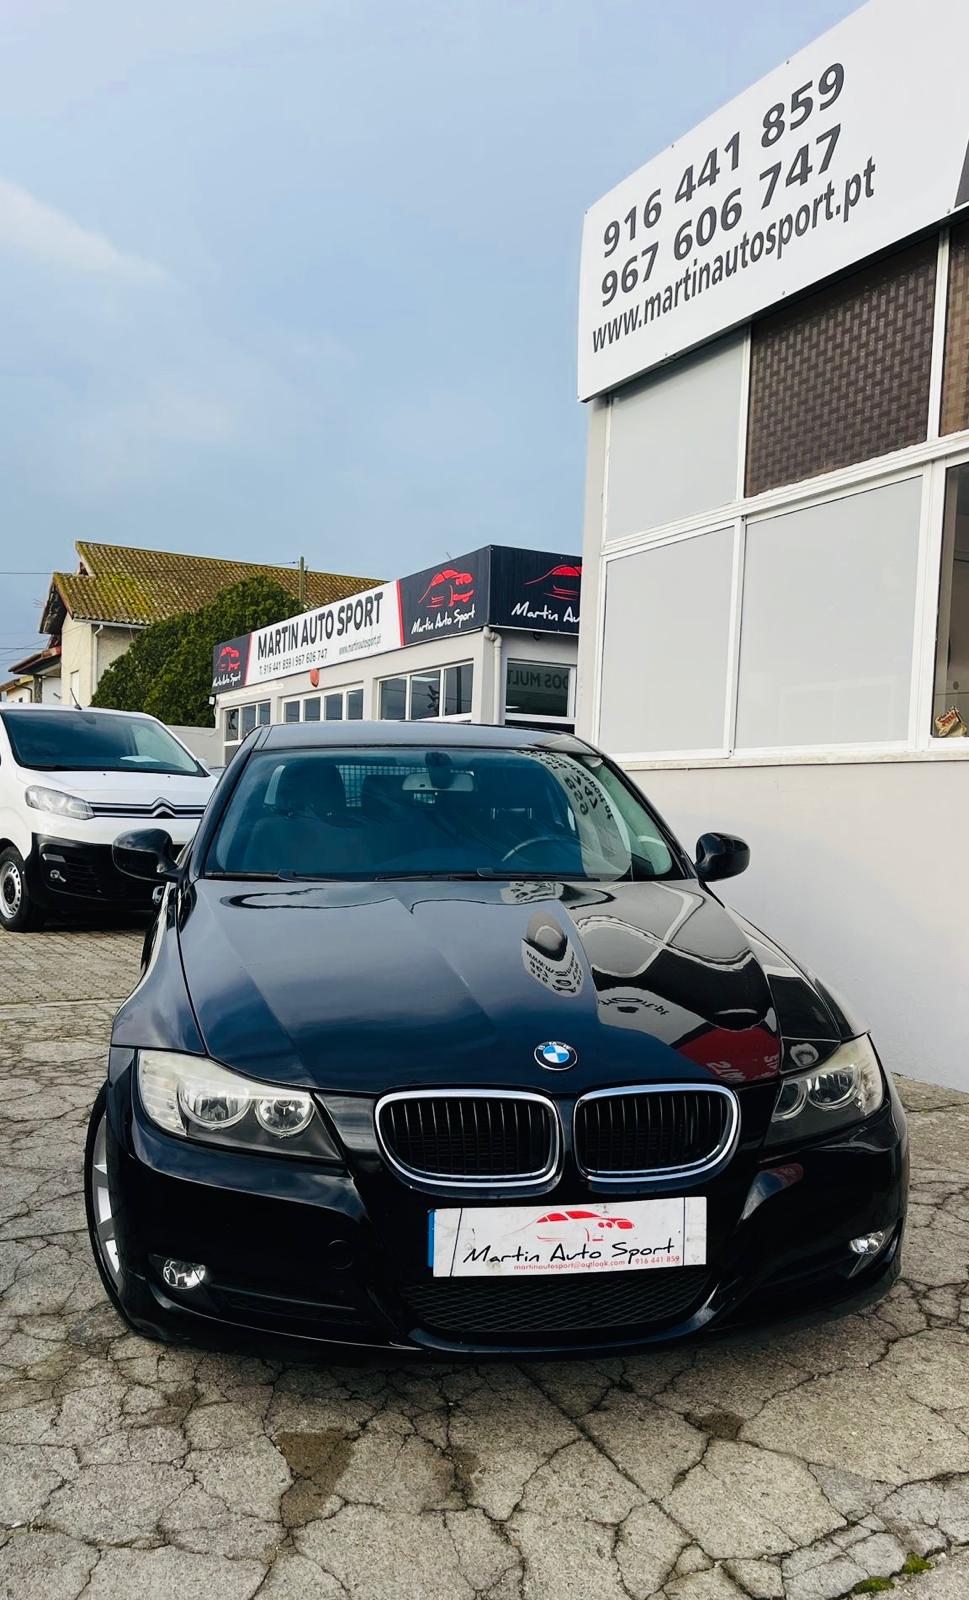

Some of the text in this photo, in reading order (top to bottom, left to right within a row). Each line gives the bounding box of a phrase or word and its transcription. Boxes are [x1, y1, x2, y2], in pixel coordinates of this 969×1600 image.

[603, 62, 845, 257] 916 441 859
[601, 124, 842, 307] 967 606 747
[592, 156, 876, 353] www.martinautosport.pt
[258, 592, 383, 661] MARTIN AUTO SPORT
[411, 603, 476, 635] Martin Auto Sport
[511, 601, 580, 623] Martin Au
[463, 1236, 675, 1265] Martin Auto Sport
[635, 1257, 649, 1265] 916
[650, 1256, 664, 1264] 441
[666, 1255, 680, 1263] 859
